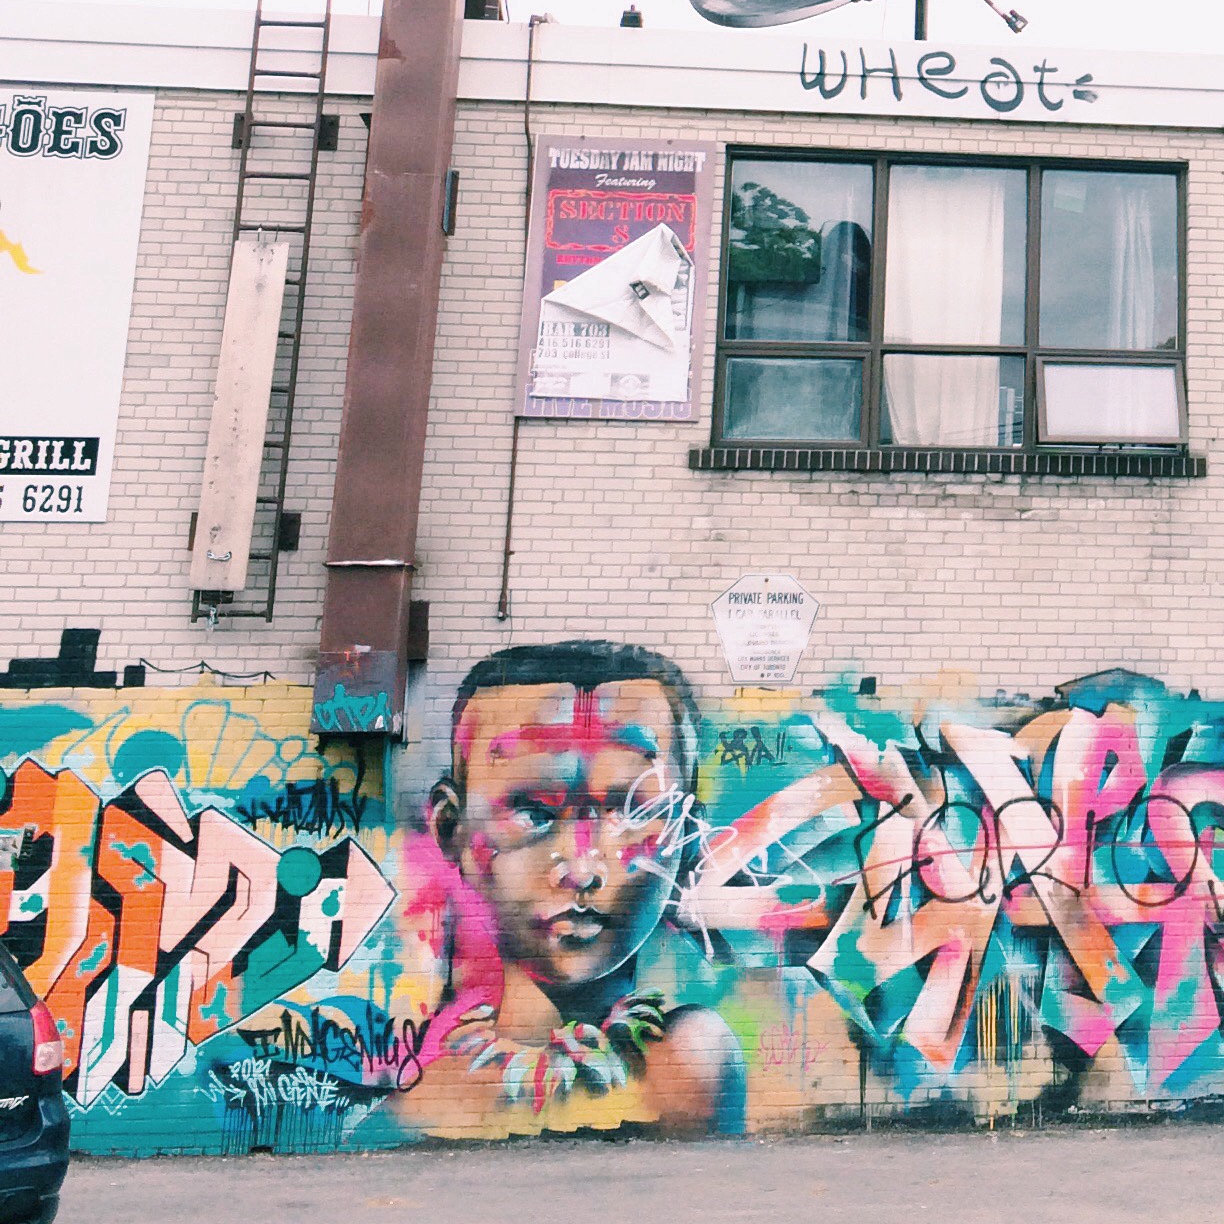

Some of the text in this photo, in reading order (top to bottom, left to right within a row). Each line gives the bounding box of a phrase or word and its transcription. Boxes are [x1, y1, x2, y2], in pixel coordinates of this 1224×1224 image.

[0, 95, 127, 160] ÕES
[548, 147, 706, 173] TUESDAY JAM NIGHT
[595, 173, 657, 190] Featuring
[559, 200, 687, 223] SECTION
[22, 484, 83, 513] 6291
[728, 592, 804, 605] PRIVATE PARKING
